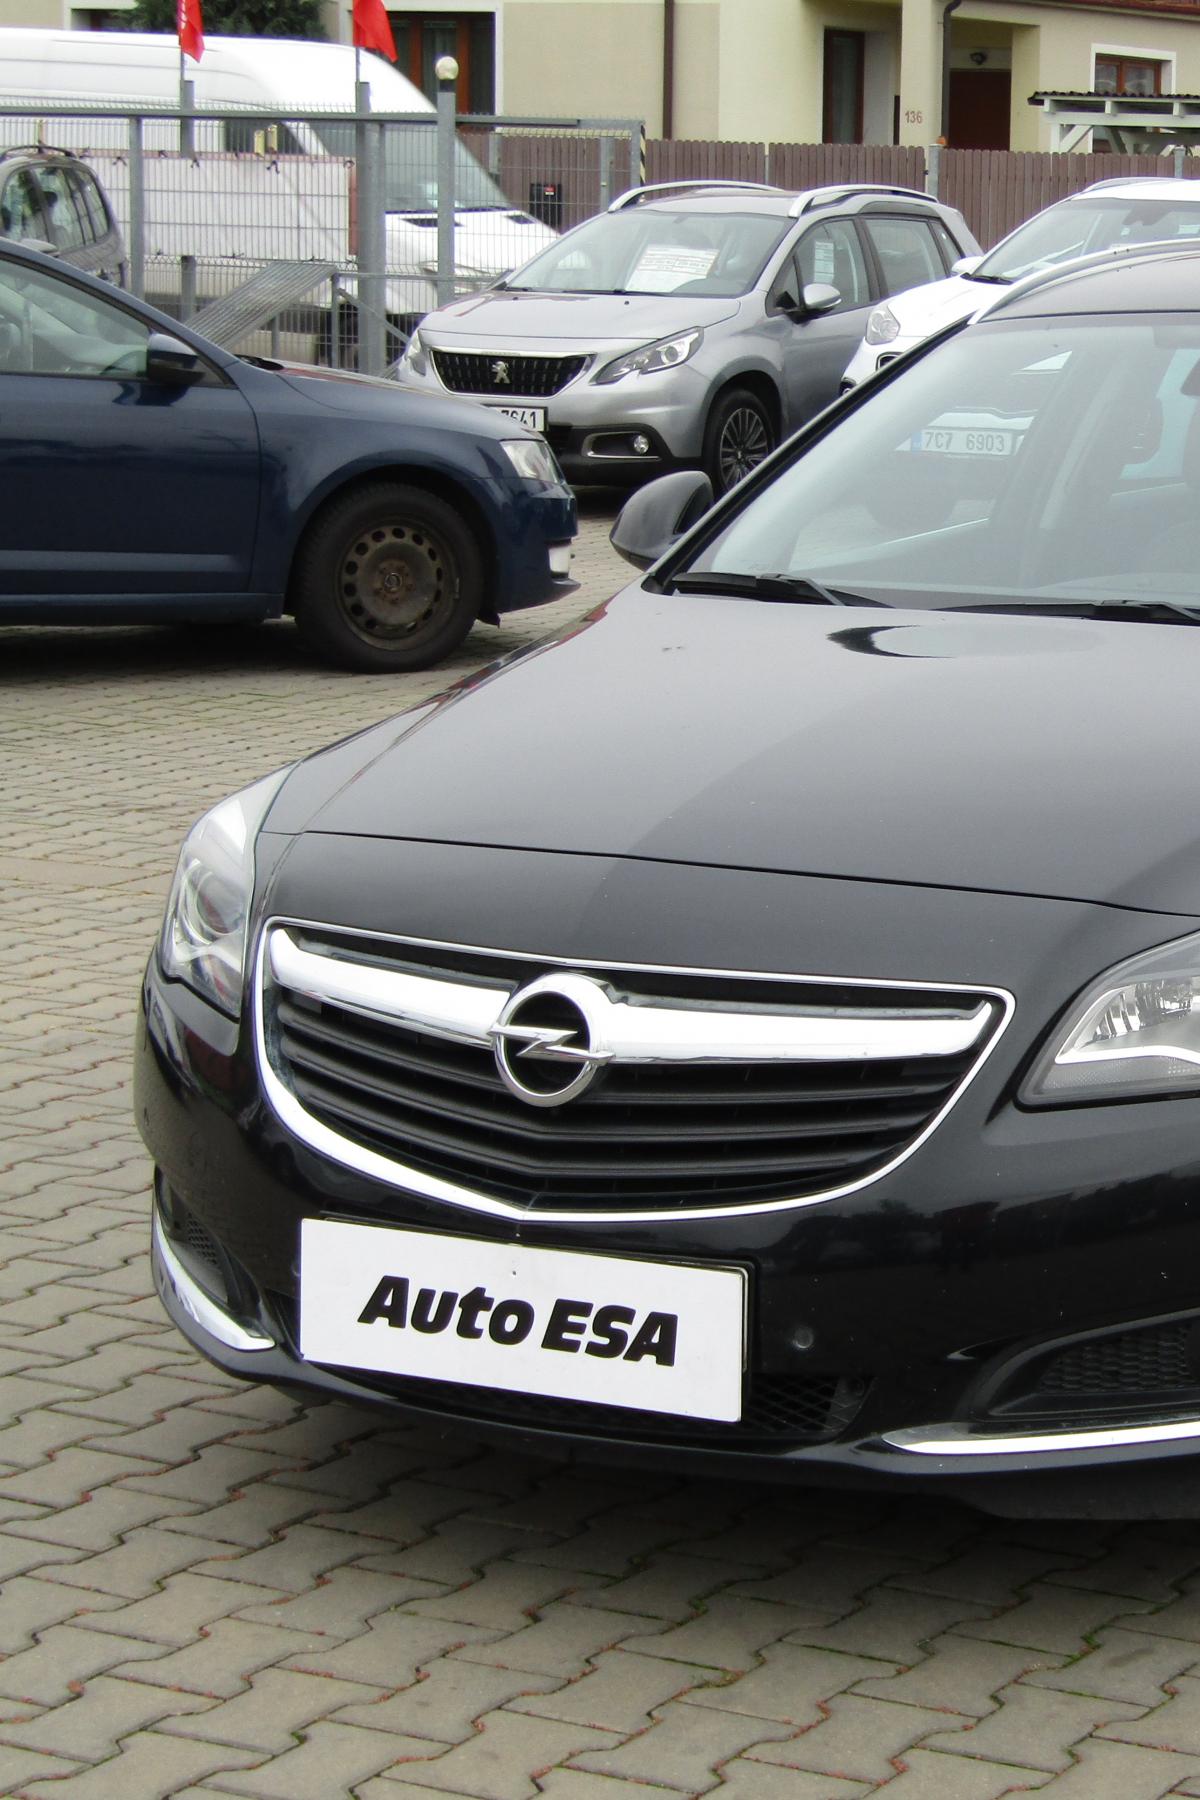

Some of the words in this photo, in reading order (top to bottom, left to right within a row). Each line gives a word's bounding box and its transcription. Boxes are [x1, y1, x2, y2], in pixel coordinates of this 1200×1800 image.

[905, 110, 923, 124] 136
[924, 431, 953, 450] 7C7
[966, 433, 1004, 452] 6903
[357, 1275, 535, 1345] Auto
[541, 1298, 678, 1367] ESA
